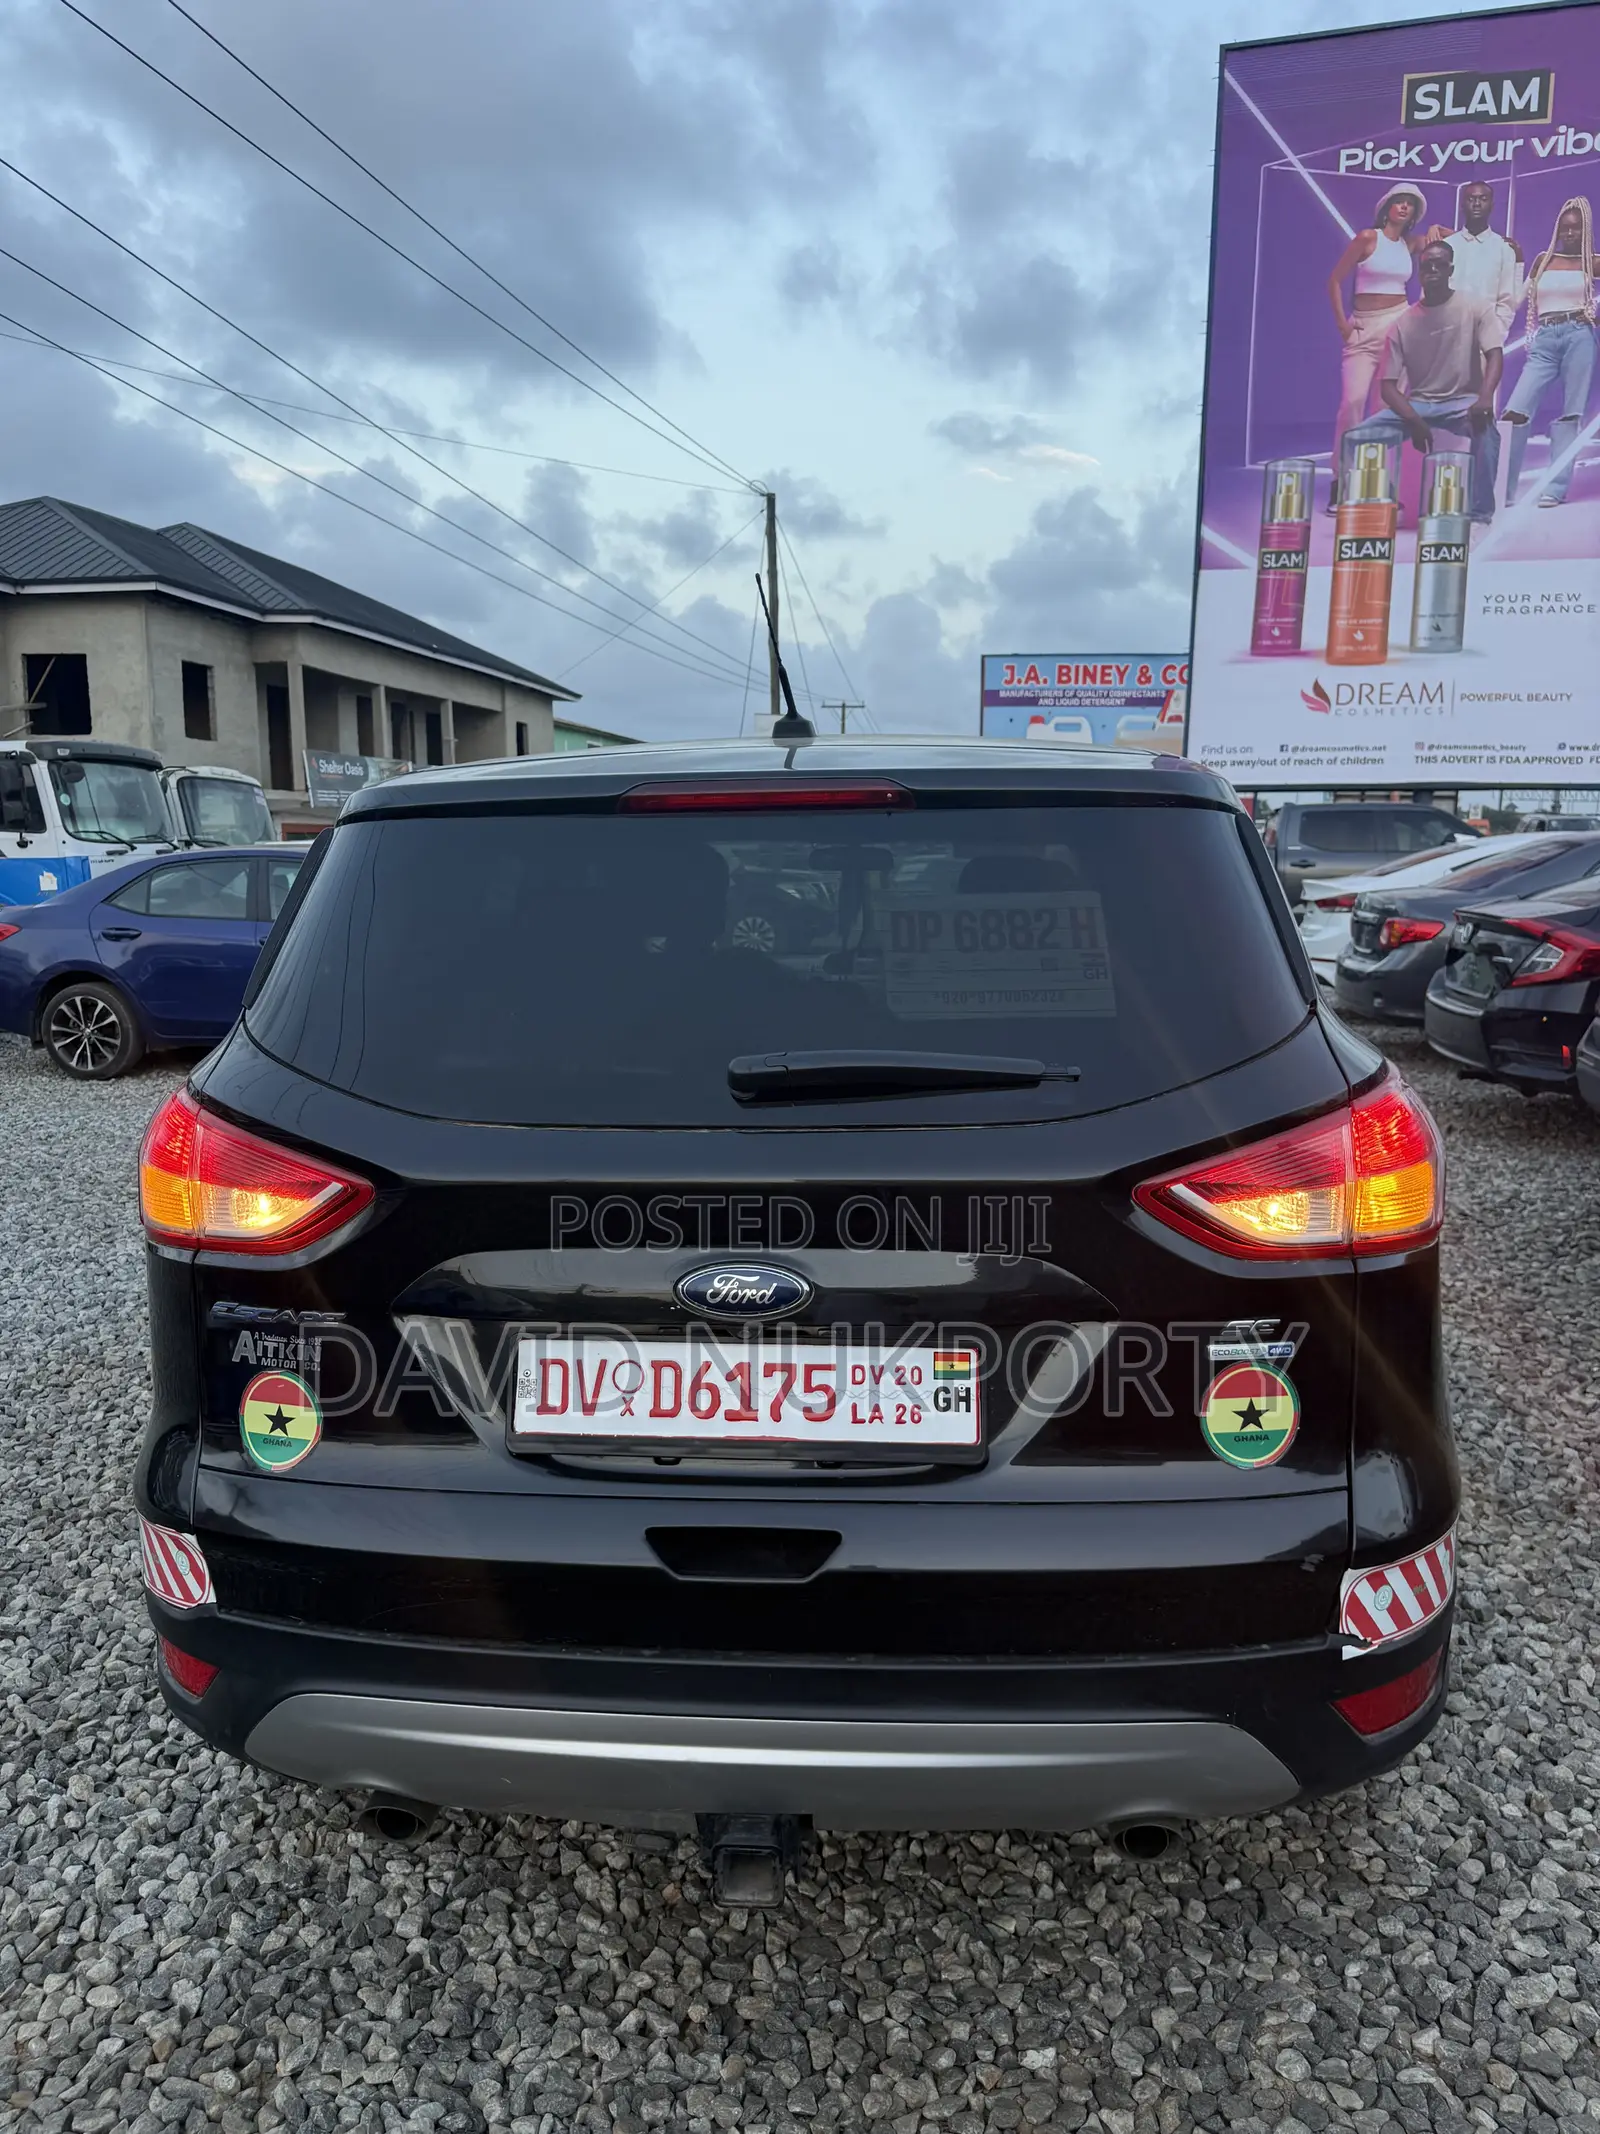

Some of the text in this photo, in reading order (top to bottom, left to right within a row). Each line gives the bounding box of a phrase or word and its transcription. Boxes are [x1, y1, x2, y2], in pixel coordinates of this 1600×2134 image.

[1413, 77, 1541, 120] SLAM
[1339, 141, 1426, 173] Pick
[1430, 138, 1523, 173] your
[1341, 540, 1390, 560] SLAM
[1421, 545, 1464, 562] SLAM
[1263, 552, 1303, 569] SLAM
[1483, 592, 1582, 604] YOUR NEW
[1482, 604, 1597, 616] FRAGRANCE
[1003, 664, 1048, 686] J.A.
[1056, 664, 1130, 686] BINEY
[1136, 665, 1152, 686] &
[999, 690, 1063, 698] MANUFACTURERS
[1065, 690, 1075, 698] OF
[1076, 690, 1108, 698] QUALITY
[1038, 698, 1126, 706] AND LIQUID DETERGENT
[1335, 681, 1445, 708] DREAM
[1460, 692, 1573, 703] POWERFUL BEAUTY
[1334, 706, 1444, 717] COSMETICS
[1201, 745, 1223, 755] Find
[1226, 746, 1238, 755] us
[319, 759, 364, 776] Shelter Oasis
[1201, 756, 1384, 769] Keep away/out of reach of children
[1415, 756, 1438, 764] THIS
[1440, 756, 1484, 764] ADVERT
[1486, 756, 1496, 764] IS
[1499, 756, 1522, 764] FDA
[1523, 756, 1583, 765] APPROVED
[706, 1273, 776, 1306] Ford
[232, 1330, 322, 1365] AITKIN
[1269, 1346, 1291, 1355] 4WD
[261, 1358, 321, 1371] MOTOR CO.
[851, 1364, 924, 1386] DV 20
[536, 1358, 837, 1423] DV D6175
[933, 1386, 972, 1413] GH
[851, 1402, 923, 1425] LA 26
[262, 1437, 293, 1448] GHANA
[1234, 1434, 1270, 1443] GHANA
